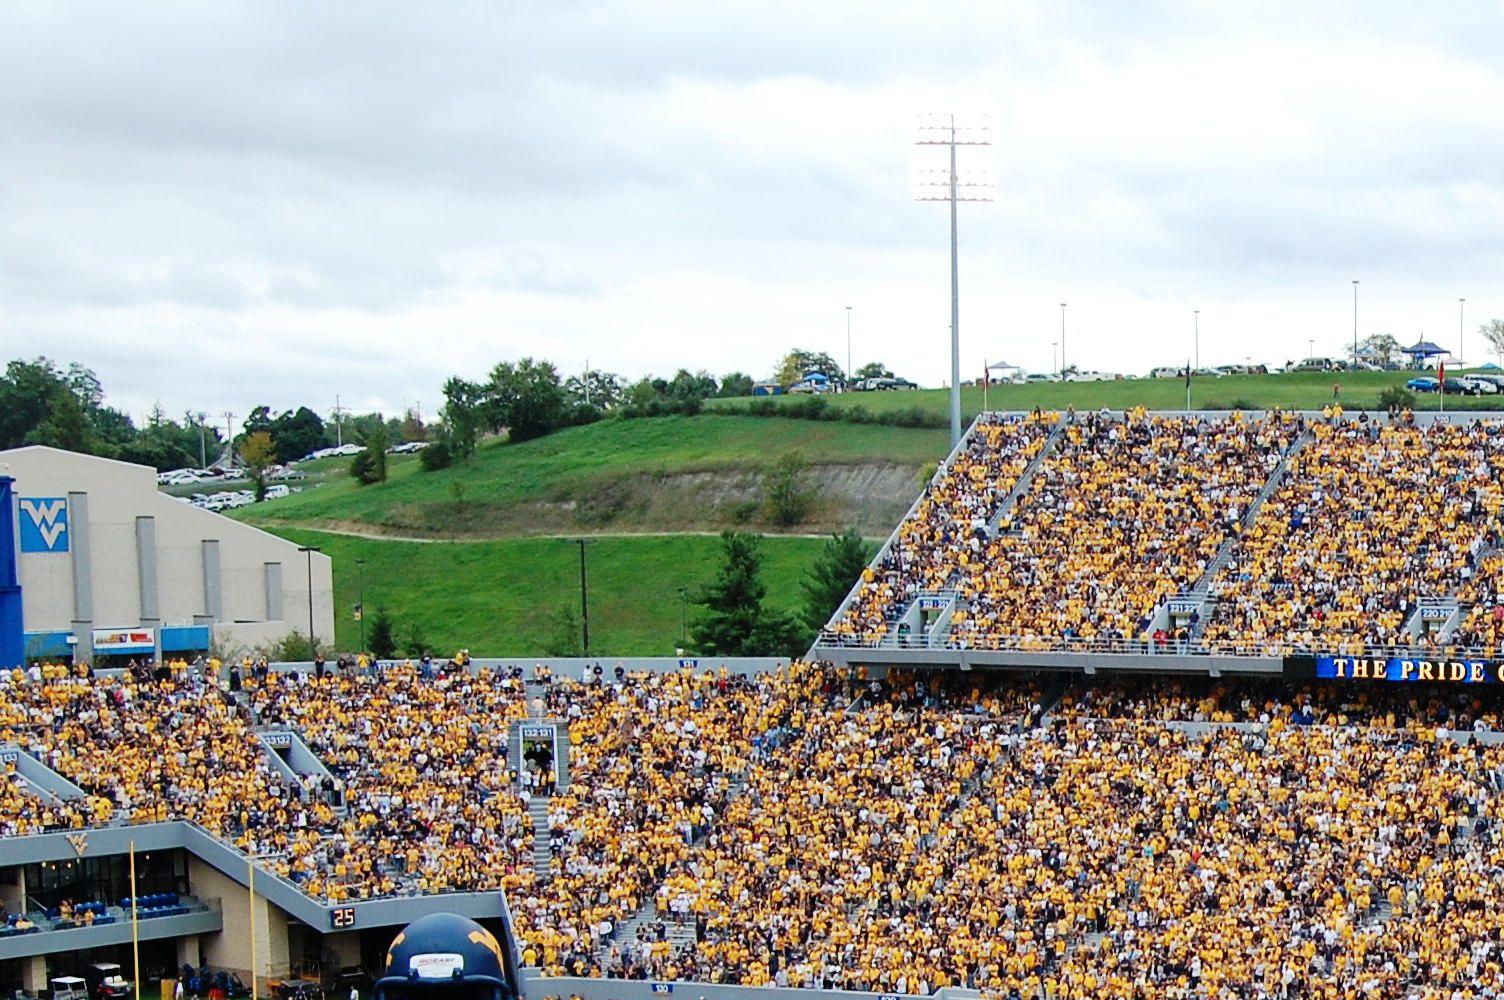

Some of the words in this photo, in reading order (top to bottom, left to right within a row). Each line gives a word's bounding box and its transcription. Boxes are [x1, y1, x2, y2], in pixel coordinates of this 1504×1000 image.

[1423, 609, 1438, 618] 220
[1333, 659, 1386, 679] THE
[1401, 661, 1485, 681] PRIDE
[334, 908, 354, 926] 25
